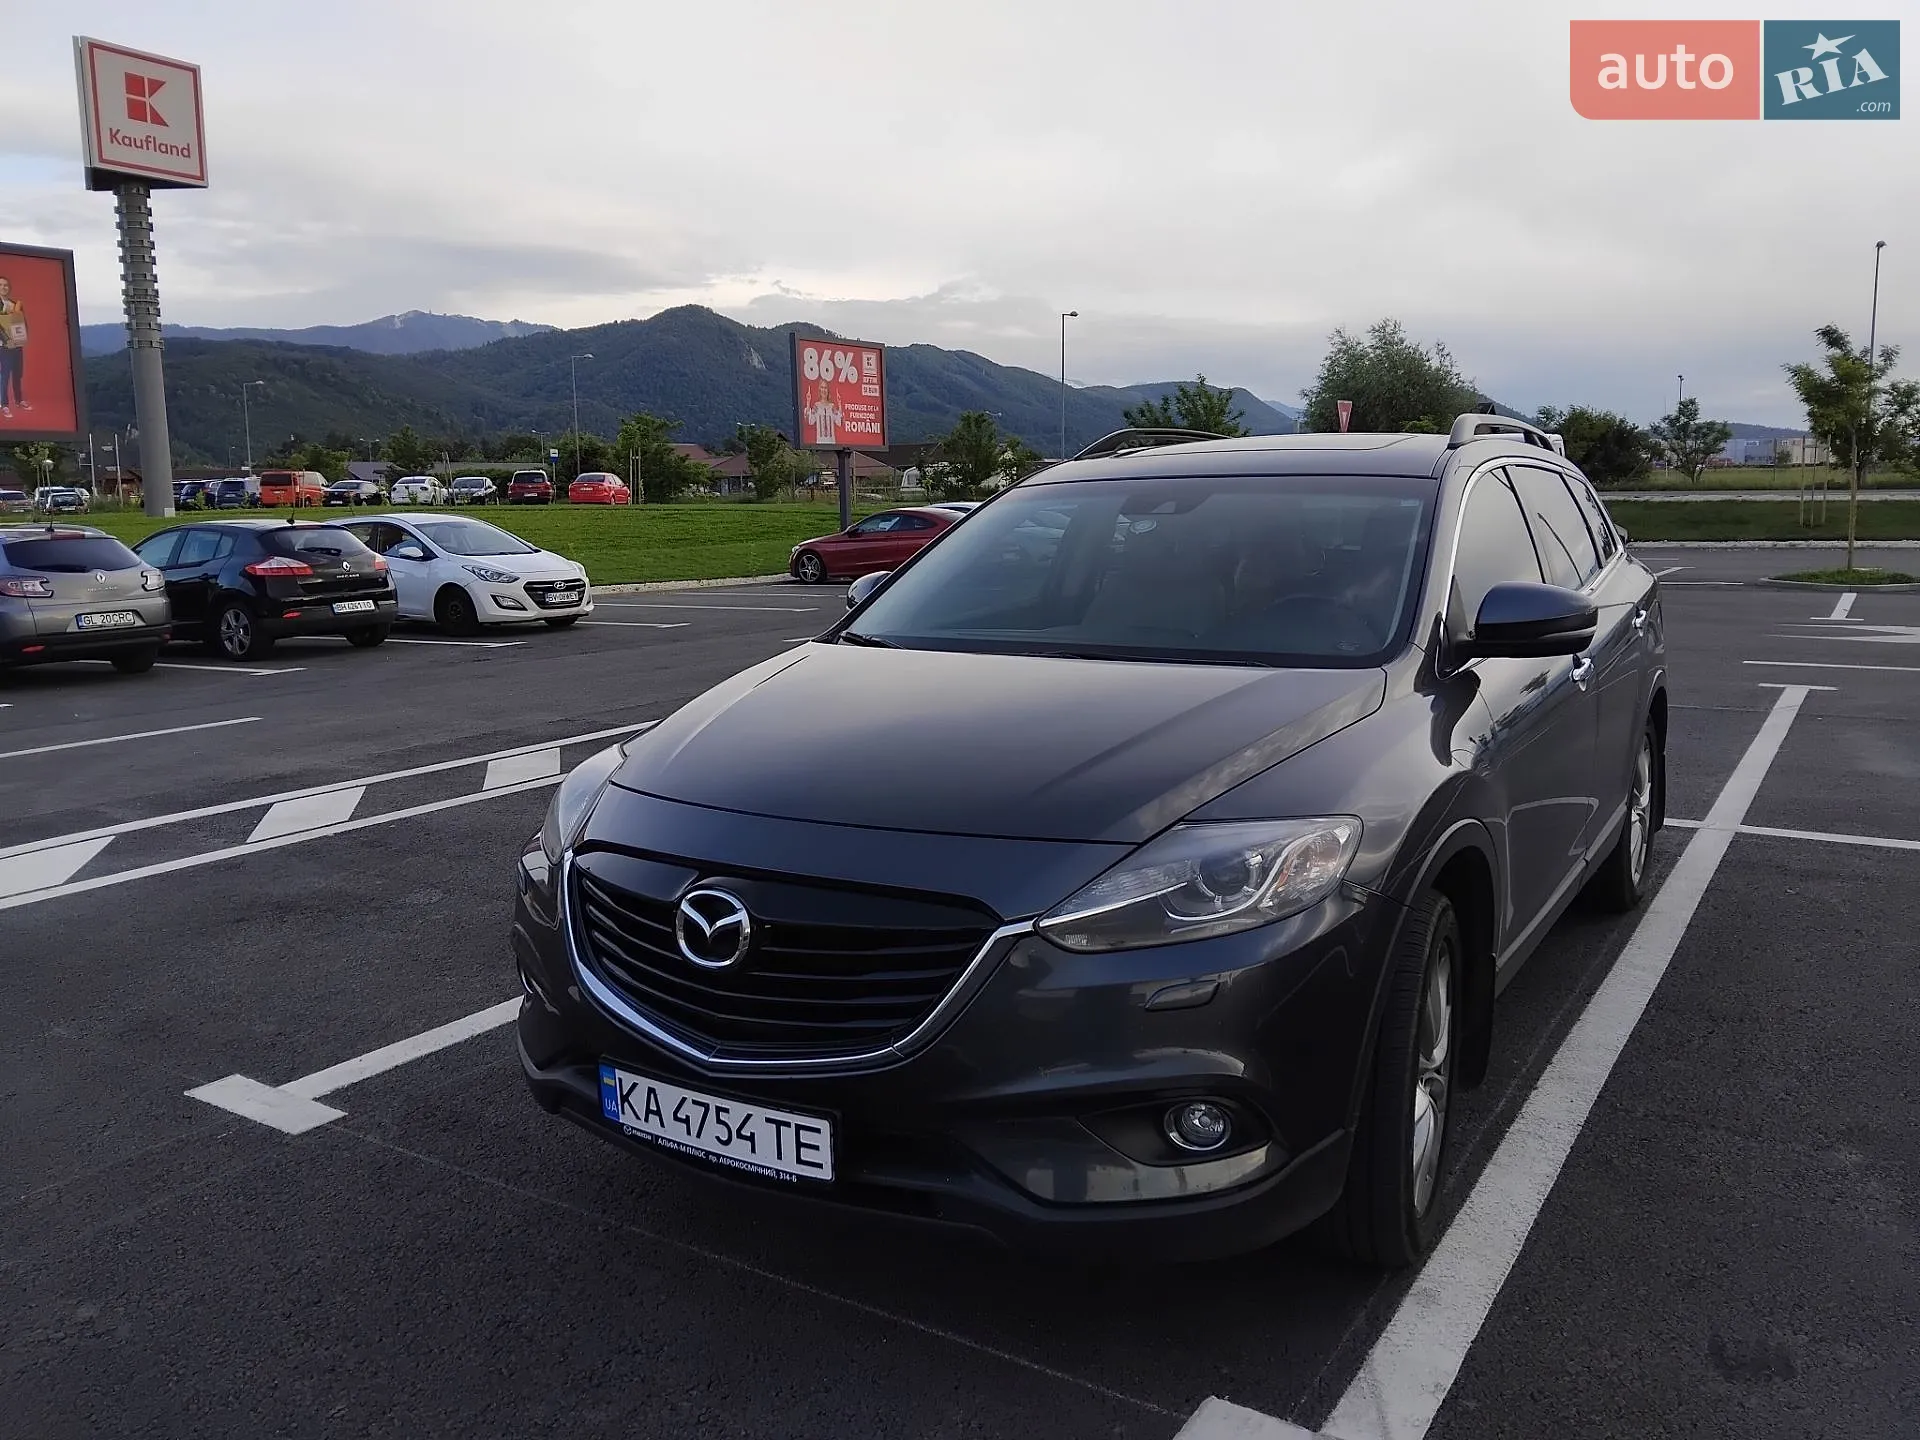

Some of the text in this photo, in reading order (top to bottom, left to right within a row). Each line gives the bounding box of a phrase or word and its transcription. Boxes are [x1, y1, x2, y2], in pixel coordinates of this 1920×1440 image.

[109, 127, 192, 159] Kaufland
[803, 347, 858, 384] 86%
[845, 419, 881, 434] ROMÂNI
[83, 615, 97, 625] GL
[605, 1100, 617, 1113] UA
[618, 1077, 824, 1170] KA 4754 TE
